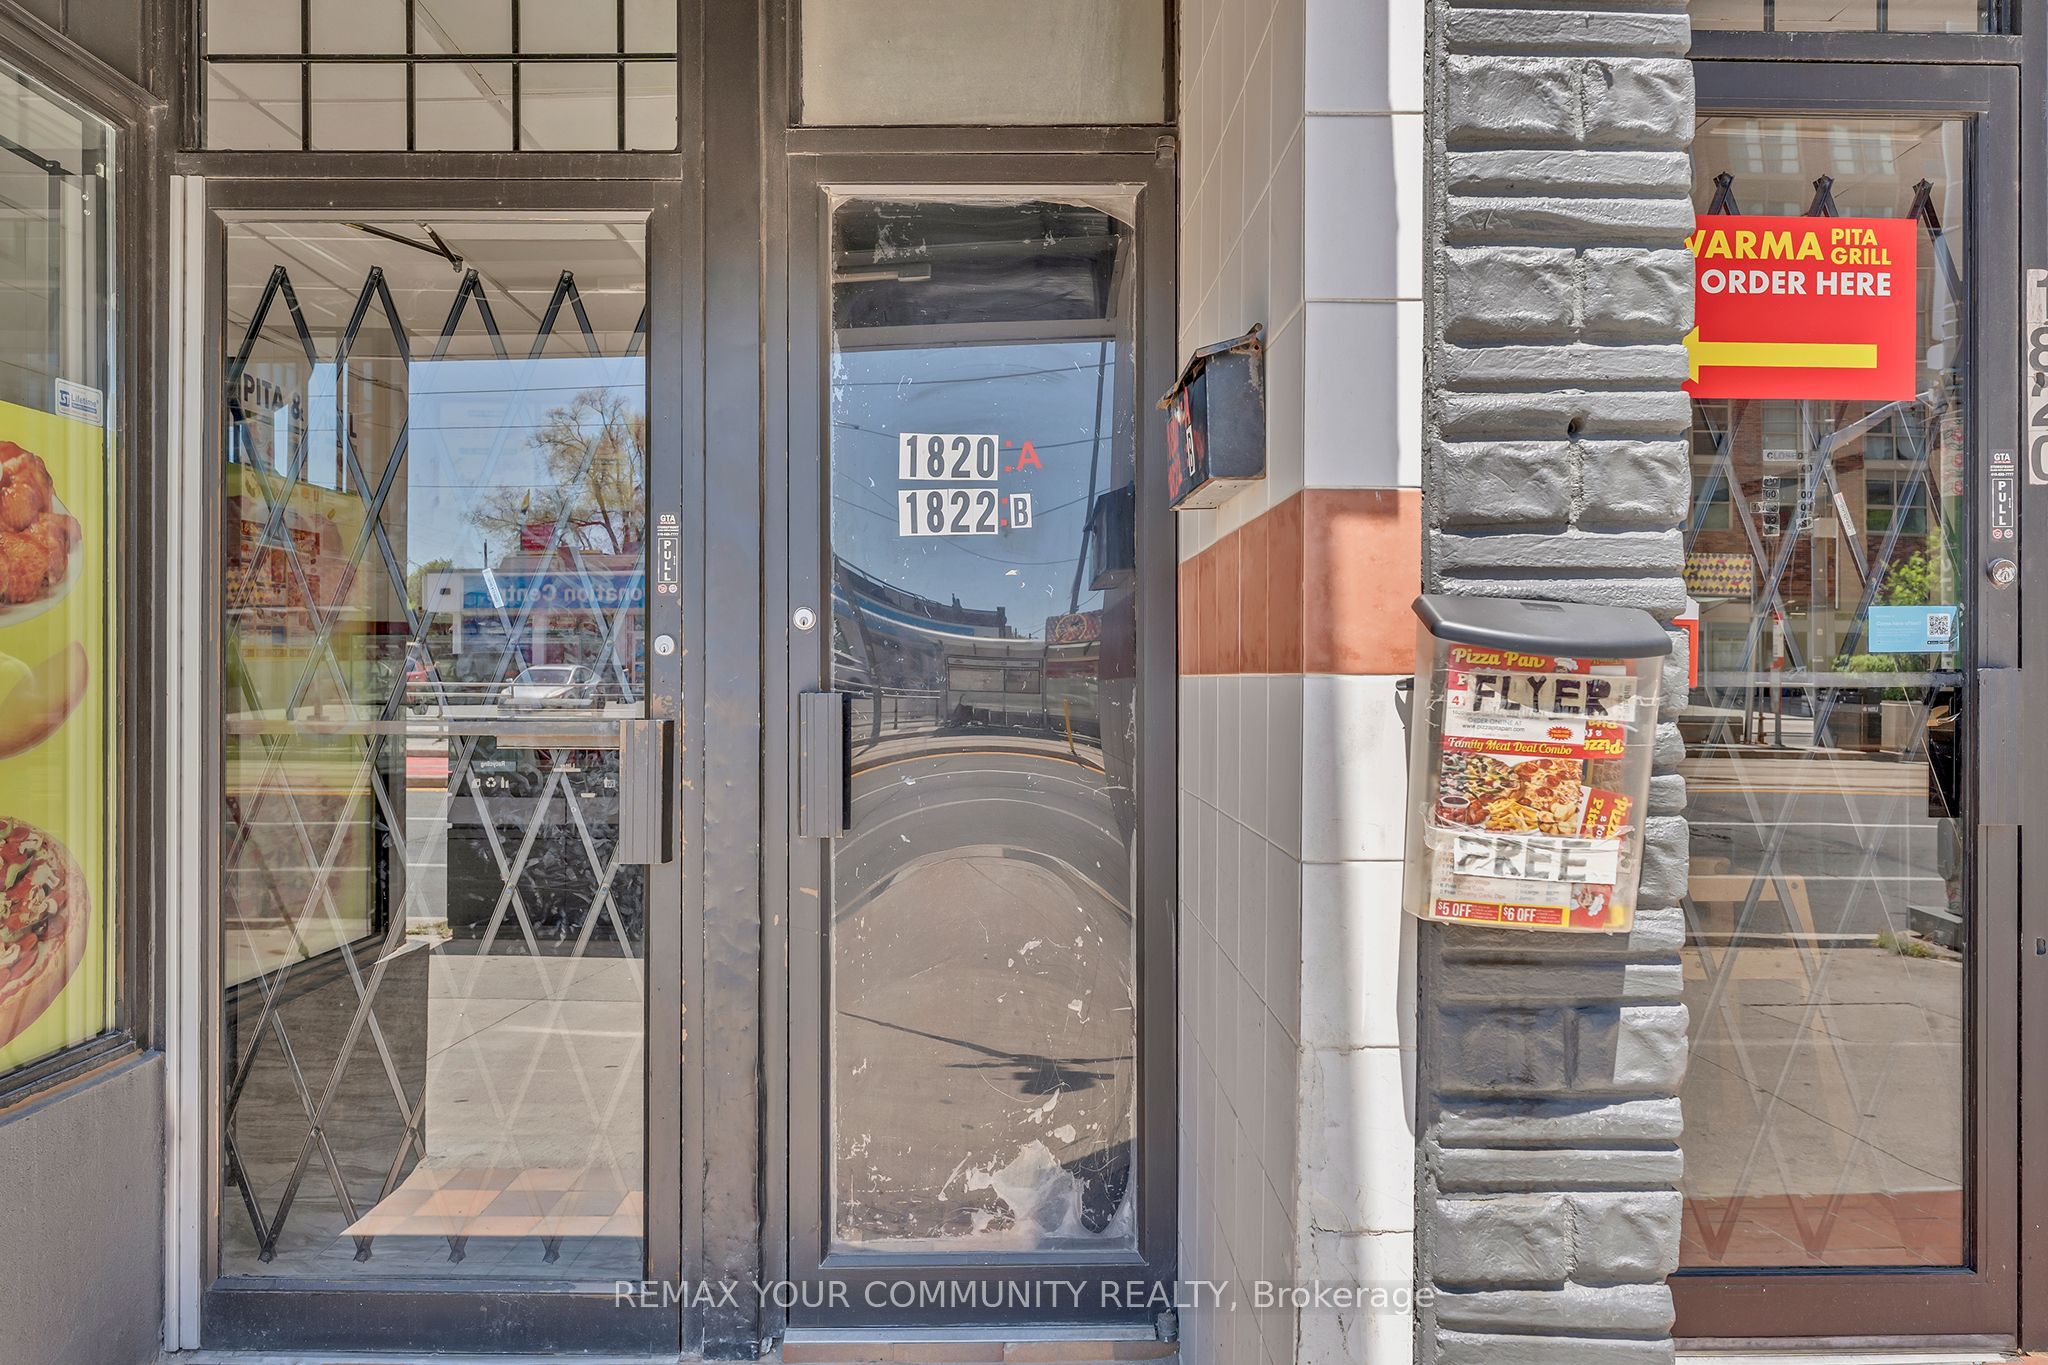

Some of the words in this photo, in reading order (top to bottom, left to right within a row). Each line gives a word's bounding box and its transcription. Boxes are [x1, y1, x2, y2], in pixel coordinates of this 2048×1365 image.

[1831, 228, 1878, 246] PITA
[1830, 247, 1892, 265] GRILL
[1700, 269, 1807, 295] ORDER
[1816, 271, 1891, 297] HERE
[243, 373, 284, 412] PITA
[906, 435, 995, 479] 1820
[1993, 453, 2011, 461] GTA
[906, 490, 996, 534] 1822
[1998, 480, 2006, 526] PULL
[660, 514, 676, 522] GTA
[663, 540, 672, 581] PULL
[1452, 648, 1501, 666] Pizza
[1504, 652, 1545, 668] Pan
[1473, 674, 1612, 716] FLYER
[1448, 737, 1483, 752] Family
[1485, 739, 1510, 751] Meal
[1512, 741, 1537, 753] Deal
[1539, 743, 1573, 755] Combo
[1457, 836, 1592, 881] FREE
[1437, 901, 1449, 916] $5
[1452, 903, 1473, 918] OFF
[1502, 906, 1514, 920] $6
[1516, 907, 1537, 922] OFF
